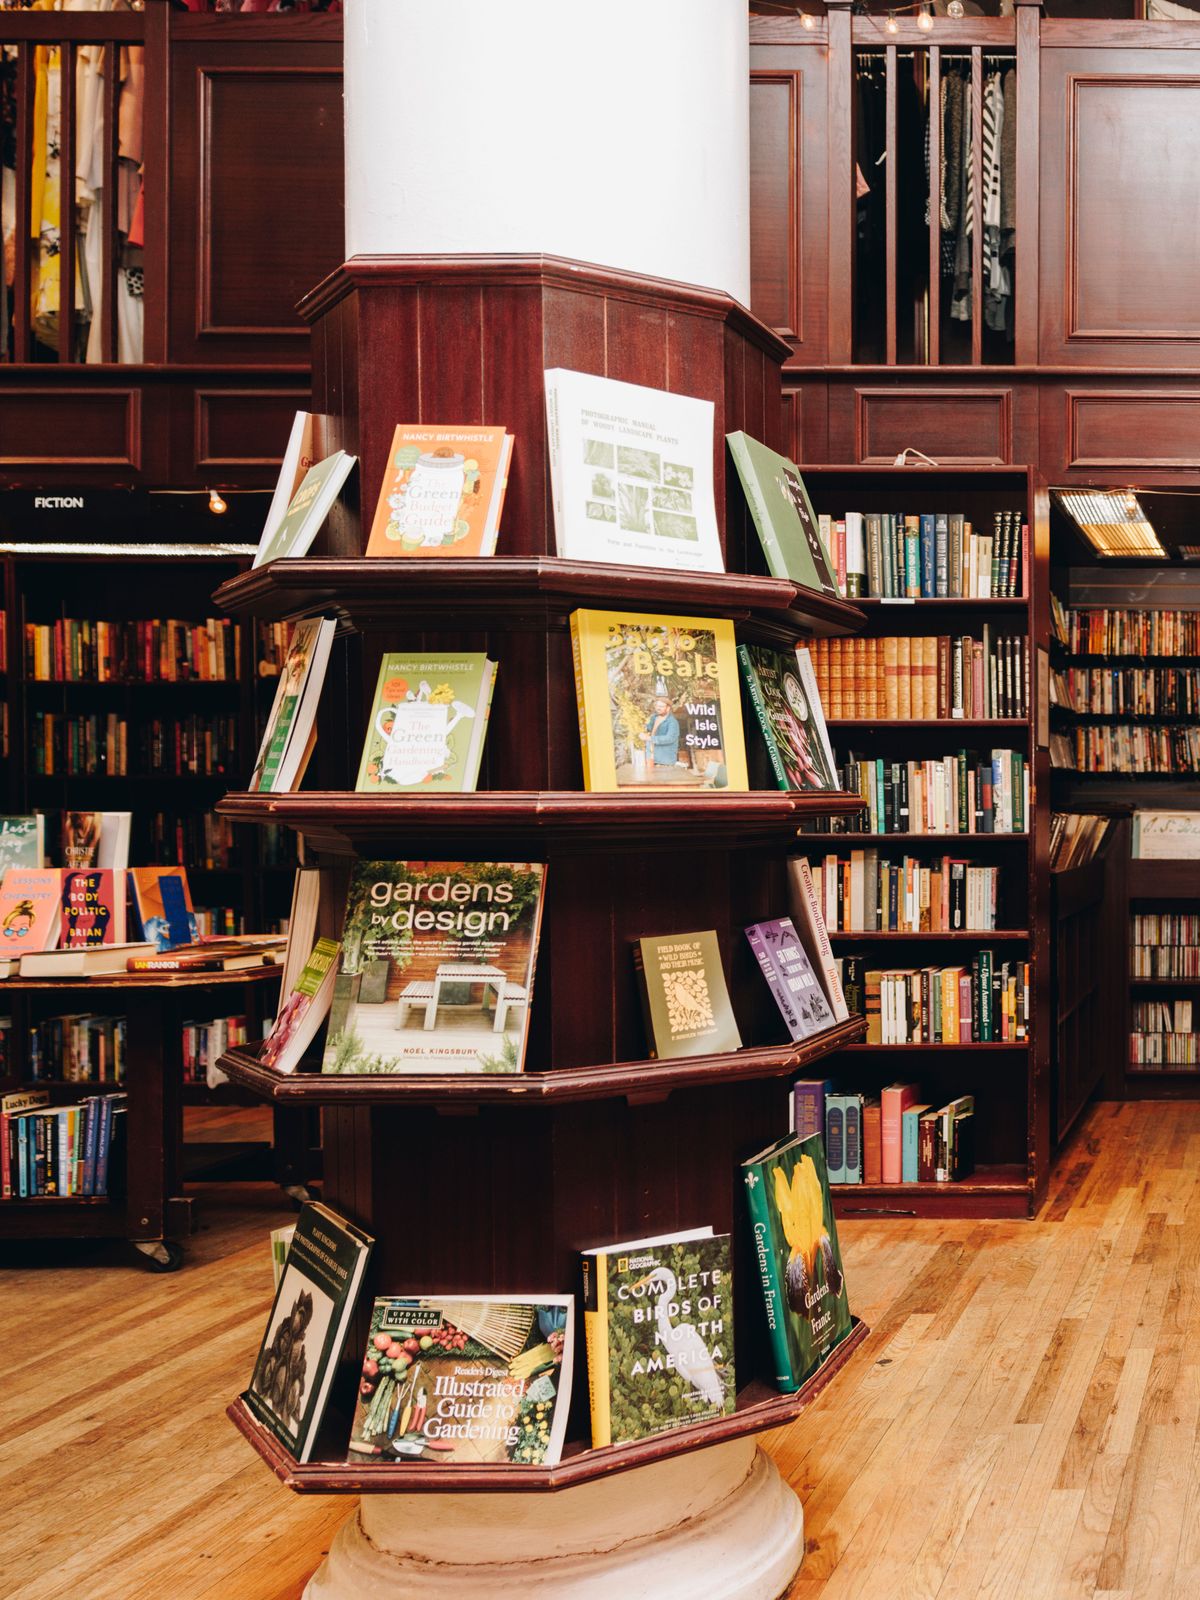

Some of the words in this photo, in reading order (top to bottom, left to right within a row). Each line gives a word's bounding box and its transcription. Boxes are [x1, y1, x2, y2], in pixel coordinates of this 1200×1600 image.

[408, 486, 459, 499] Green
[35, 497, 84, 508] FICTION
[635, 650, 719, 678] Beale
[685, 703, 716, 716] Wild
[696, 719, 717, 731] Isle
[392, 728, 444, 742] Green
[686, 735, 719, 749] Style
[2, 821, 36, 835] Last
[66, 848, 94, 856] CHRISTIE
[70, 893, 99, 902] BODY
[370, 877, 513, 908] gardens
[64, 907, 106, 916] POLITIC
[371, 913, 390, 927] by
[392, 904, 510, 937] design
[70, 928, 102, 937] BRIAN
[801, 864, 814, 899] Creative
[810, 901, 830, 956] Bookbinding
[828, 968, 841, 1003] Johnson
[657, 945, 673, 954] FIELD
[674, 943, 691, 952] BOOK
[680, 952, 697, 960] BIRDS
[980, 968, 989, 988] Ulysses
[5, 1099, 27, 1109] Lucky
[312, 1227, 323, 1241] PLANT
[321, 1235, 337, 1252] KINGDOMS
[754, 1223, 767, 1273] Gardens
[300, 1235, 320, 1257] PHOTOGRAPHS
[324, 1255, 338, 1271] CHARLES
[336, 1266, 348, 1280] JONES
[629, 1260, 661, 1270] GEOGRAPHIC
[761, 1275, 773, 1284] in
[805, 1282, 830, 1309] Gardens
[634, 1300, 691, 1323] BIRDS
[698, 1295, 721, 1311] OF
[764, 1289, 776, 1330] France
[411, 1318, 438, 1326] COLOR
[811, 1311, 831, 1335] France
[655, 1320, 723, 1345] NORTH
[632, 1346, 723, 1375] AMERICA
[454, 1366, 484, 1376] Reader's
[485, 1368, 508, 1378] Digest
[433, 1376, 524, 1398] Illustrated
[437, 1397, 494, 1418] Guide
[496, 1401, 514, 1418] to
[423, 1417, 520, 1445] Gardening
